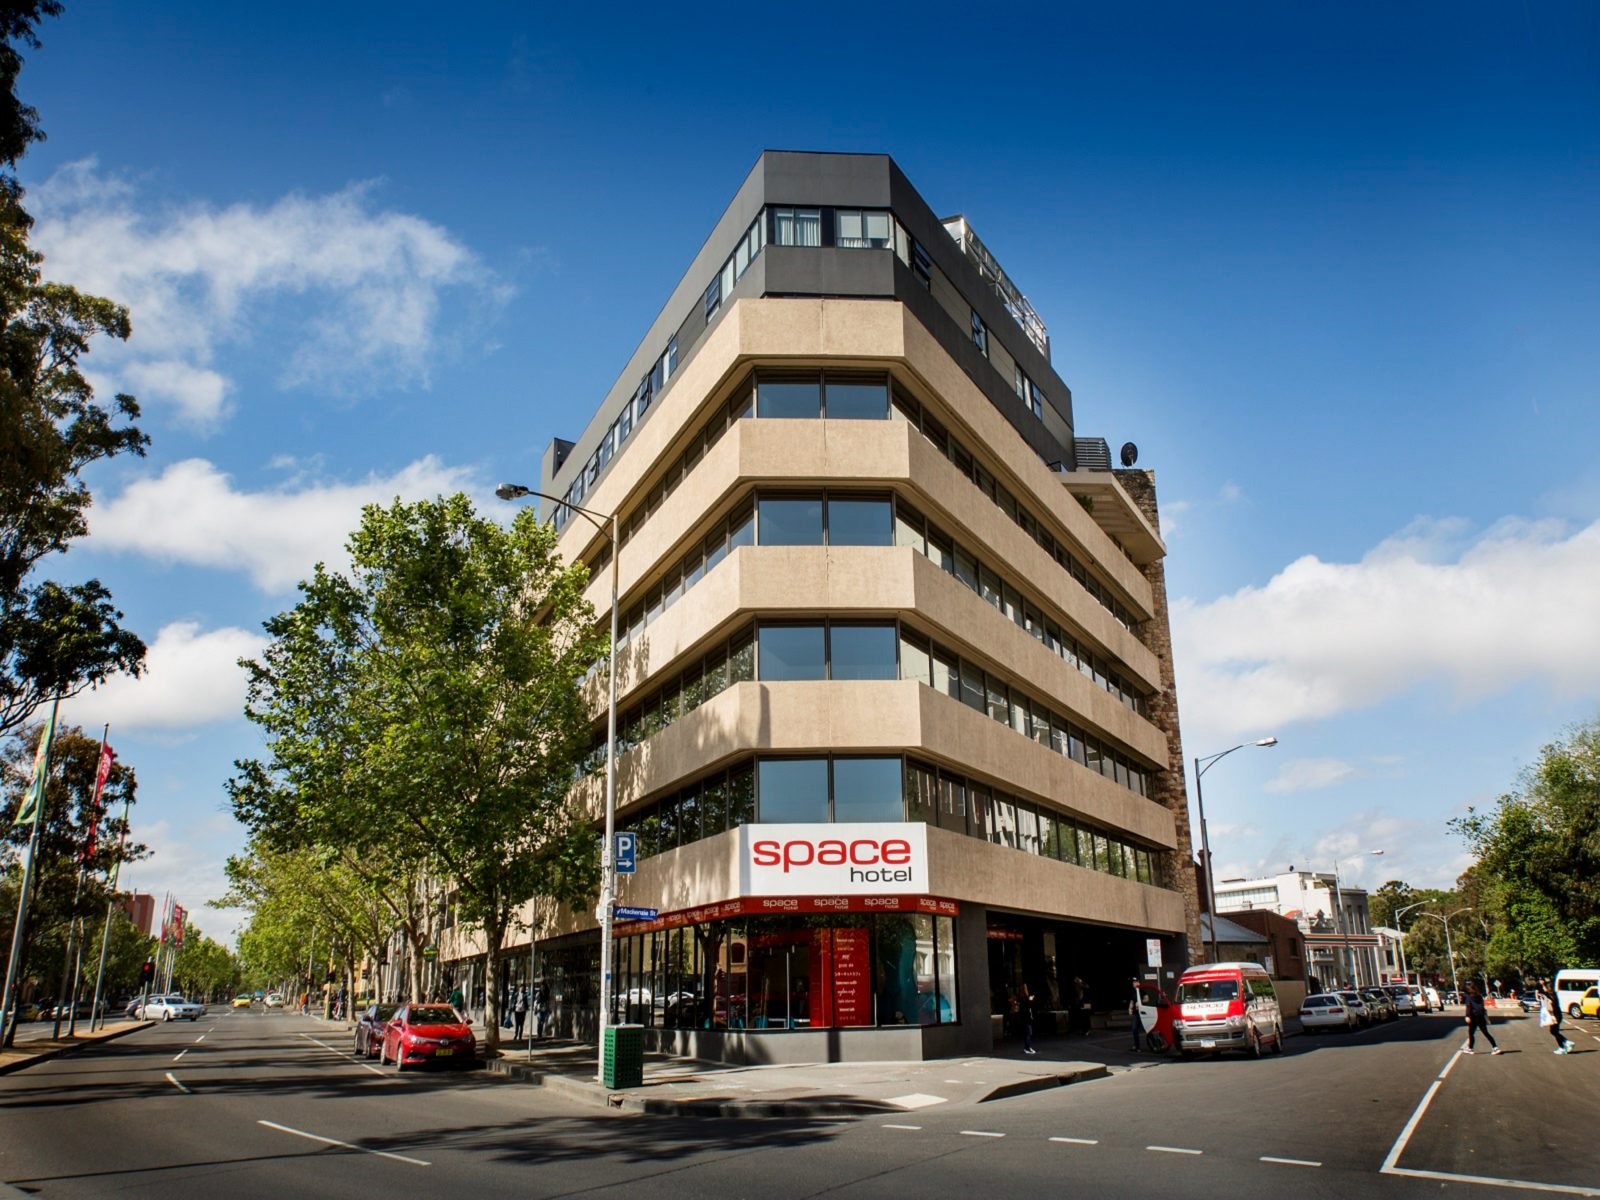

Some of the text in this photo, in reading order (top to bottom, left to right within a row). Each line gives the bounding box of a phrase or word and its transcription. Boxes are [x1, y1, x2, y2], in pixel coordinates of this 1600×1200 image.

[618, 837, 632, 857] P
[753, 838, 911, 873] space
[850, 866, 912, 882] hotel
[763, 899, 798, 907] space
[814, 898, 849, 906] space
[864, 897, 899, 906] space
